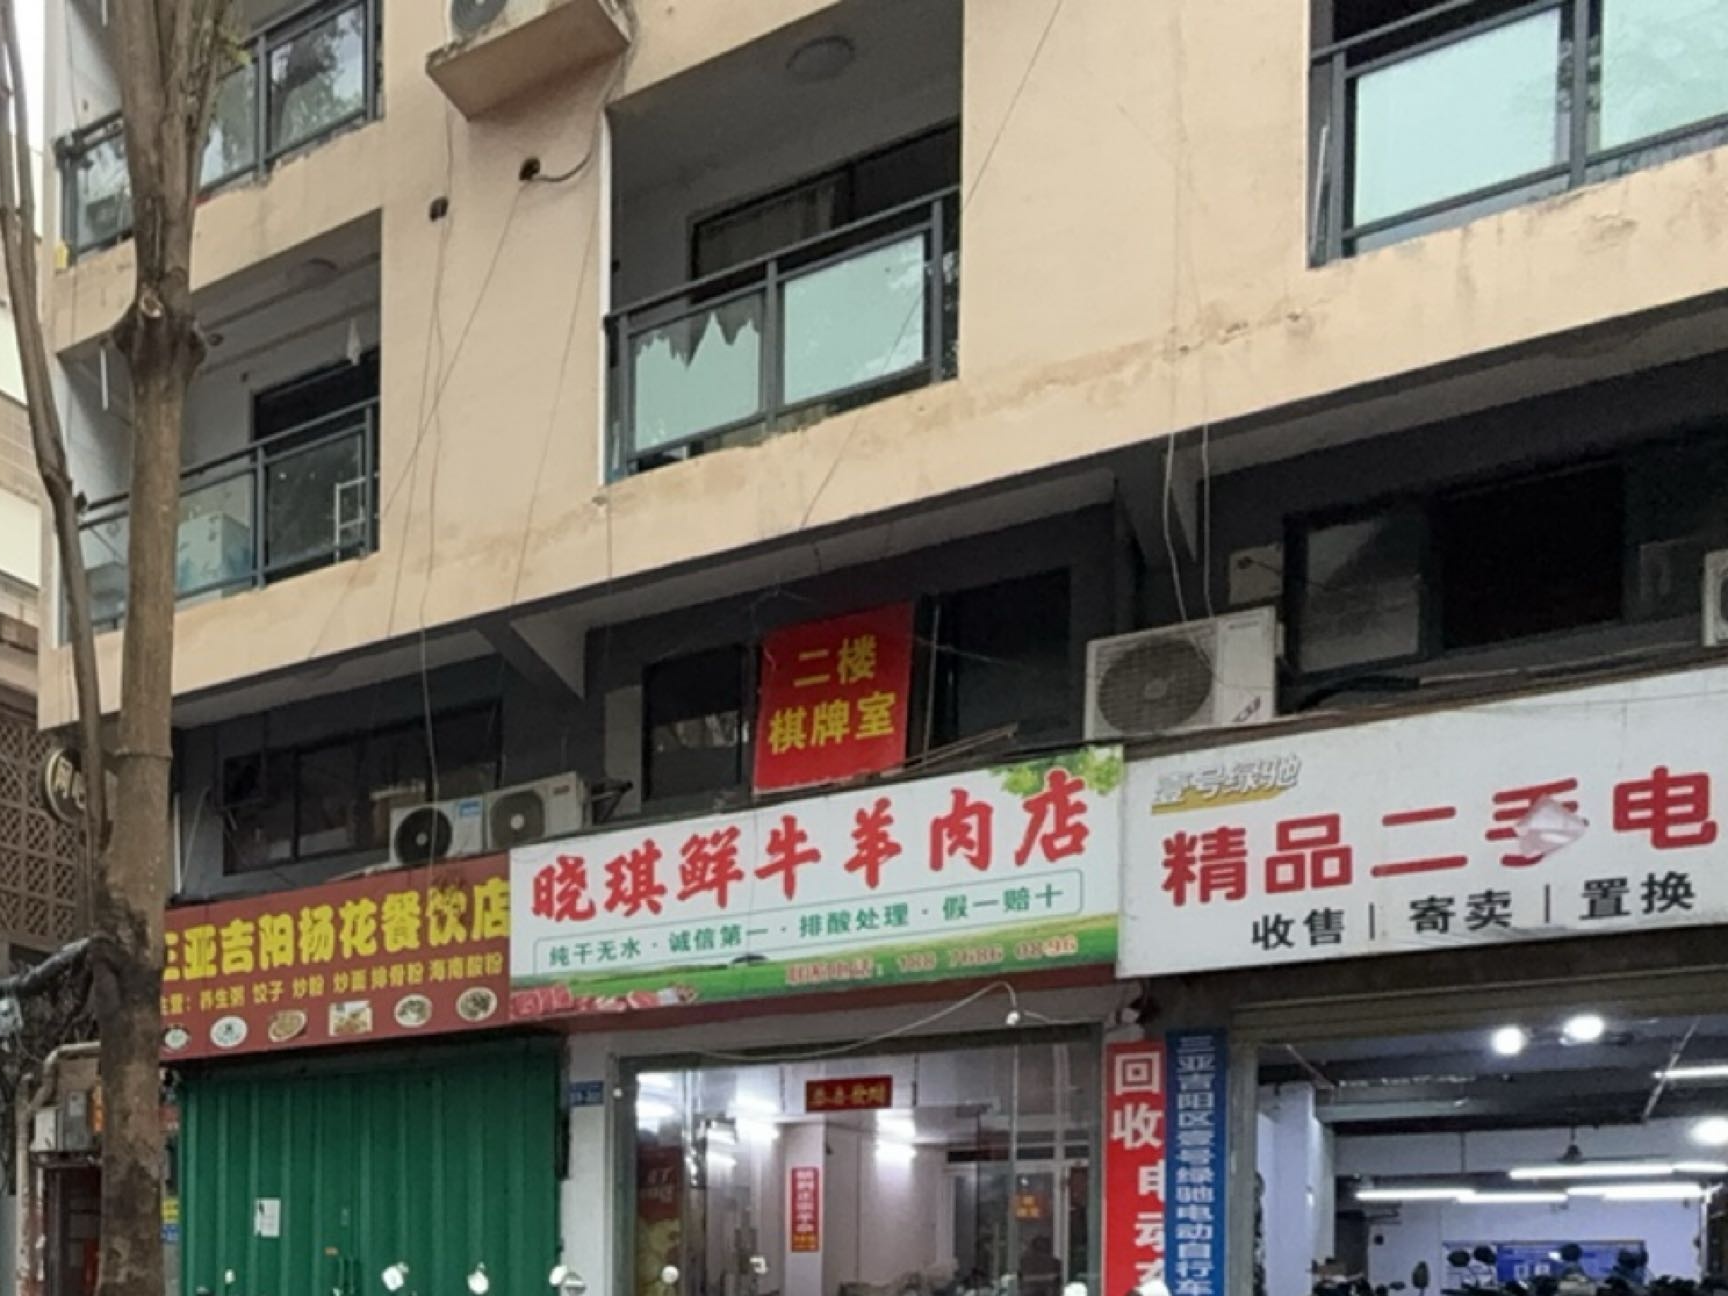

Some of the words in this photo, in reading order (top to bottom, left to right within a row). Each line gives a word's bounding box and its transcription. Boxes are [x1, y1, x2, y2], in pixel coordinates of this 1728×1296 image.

[792, 634, 877, 688] 二楼
[768, 690, 897, 755] 棋牌室
[530, 769, 1091, 925] 晓琪鲜牛羊肉店
[1251, 906, 1346, 952] 收售
[1409, 889, 1514, 934] 寄卖
[1580, 870, 1696, 921] 置换
